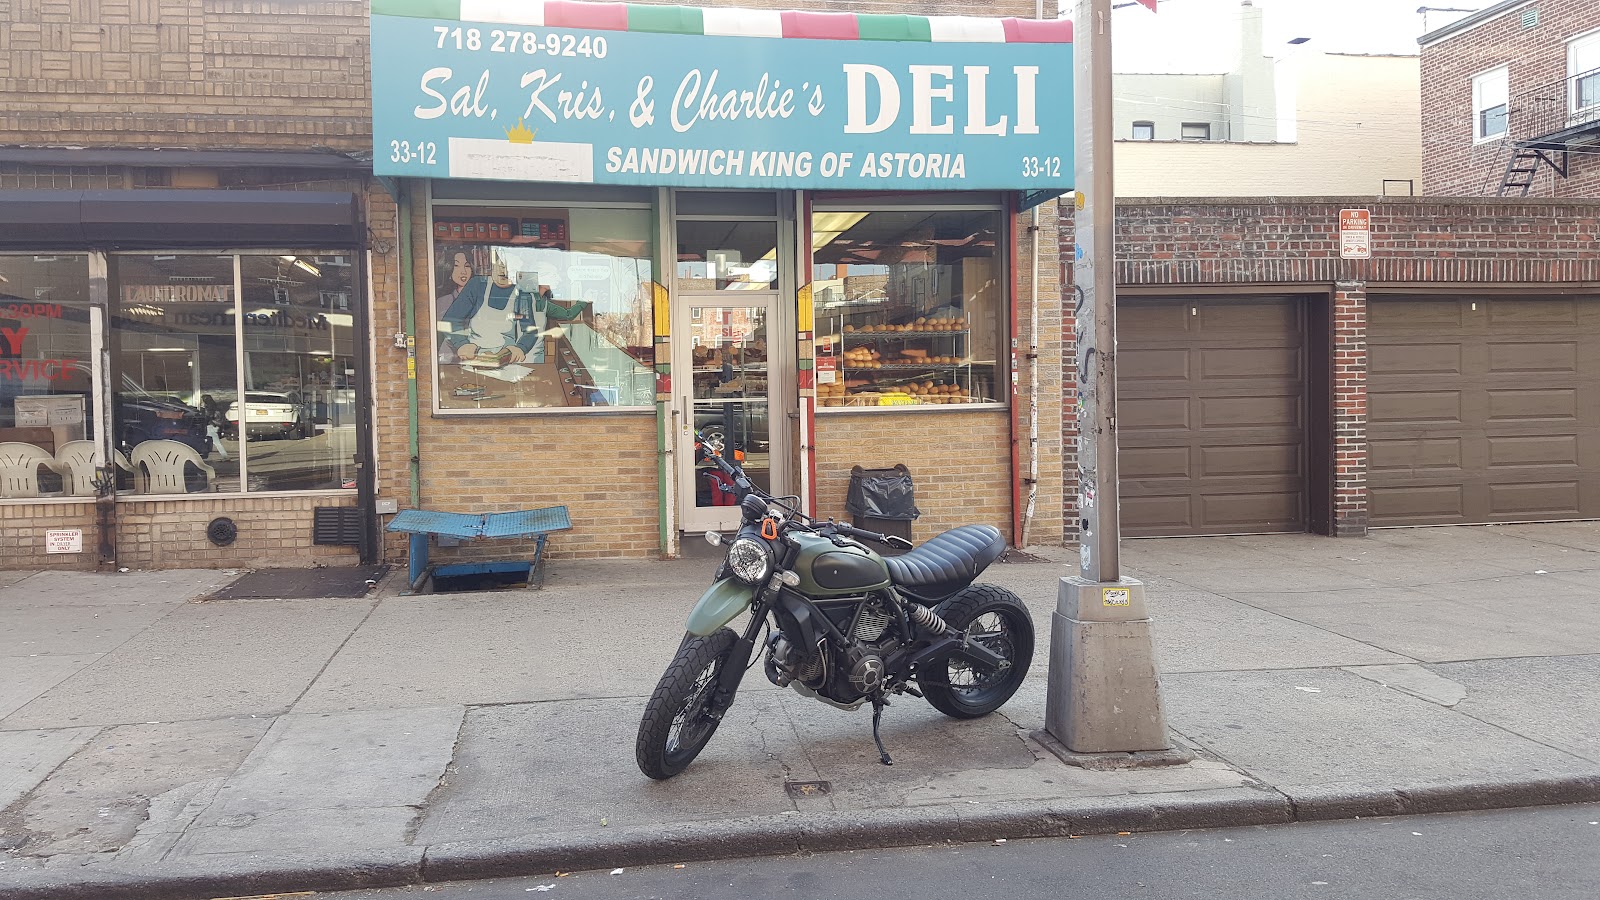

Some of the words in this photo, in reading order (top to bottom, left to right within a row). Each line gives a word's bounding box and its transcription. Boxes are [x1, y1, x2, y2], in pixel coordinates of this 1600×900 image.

[433, 26, 482, 51] 718
[490, 29, 608, 59] 278-9240
[413, 67, 497, 120] Sal,
[520, 68, 615, 124] Kris,
[629, 75, 655, 129] &
[670, 68, 826, 133] Charlie's
[843, 64, 1040, 136] DELI
[390, 139, 437, 165] 33-12
[605, 146, 745, 175] SANDWICH
[749, 151, 813, 177] KING
[820, 152, 854, 178] OF
[860, 153, 966, 179] ASTORIA
[1022, 156, 1061, 178] 33-12
